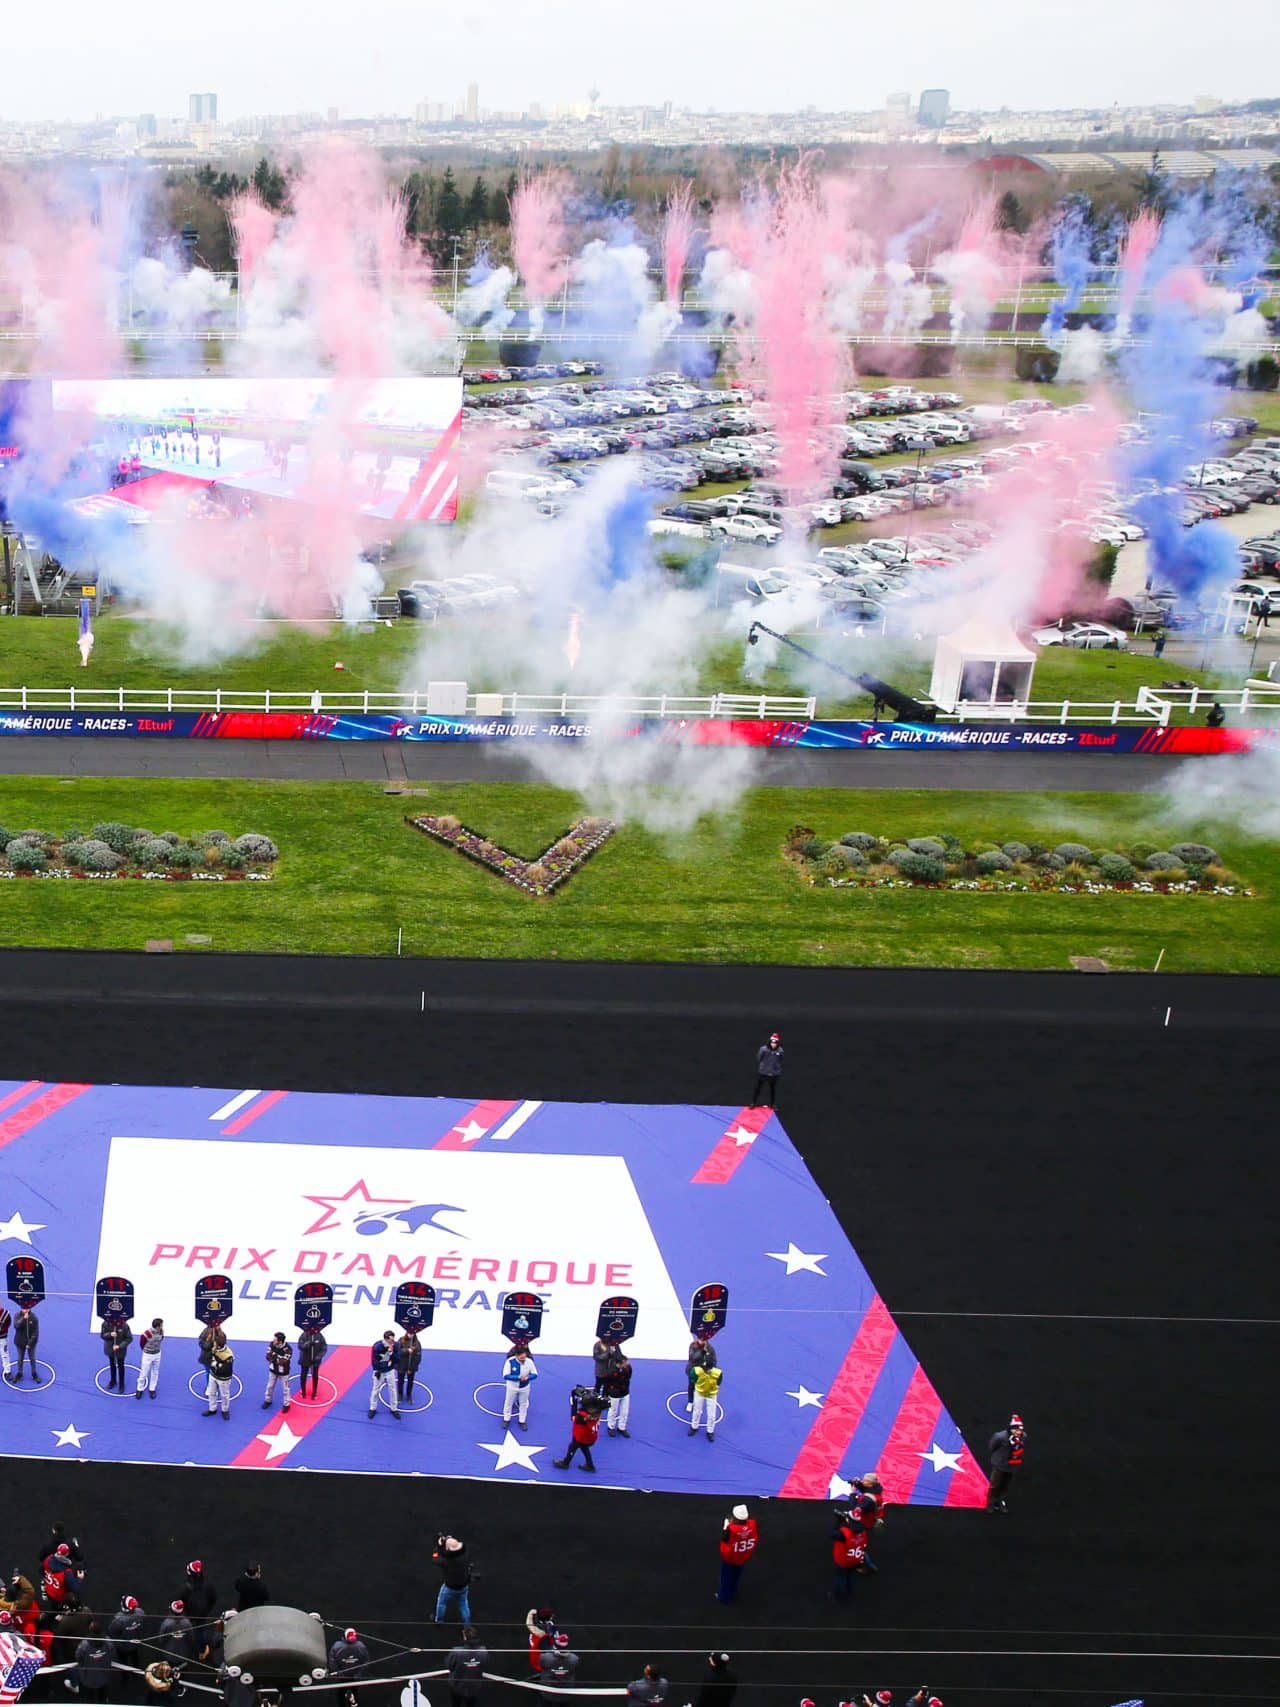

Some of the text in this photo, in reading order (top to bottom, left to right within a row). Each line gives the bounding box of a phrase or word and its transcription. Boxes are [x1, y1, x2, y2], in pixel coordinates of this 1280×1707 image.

[419, 723, 453, 735] PRIX
[454, 721, 537, 736] D'AMÉRIQUE
[890, 730, 922, 742] PRIX
[926, 728, 1010, 744] D'AMÉRIQUE
[15, 1259, 35, 1271] 10
[149, 1243, 633, 1287] PRIX D'AMÉRIQUE
[205, 1276, 225, 1289] 12
[407, 1283, 427, 1296] 14
[305, 1284, 324, 1297] 13
[732, 1538, 756, 1553] 135
